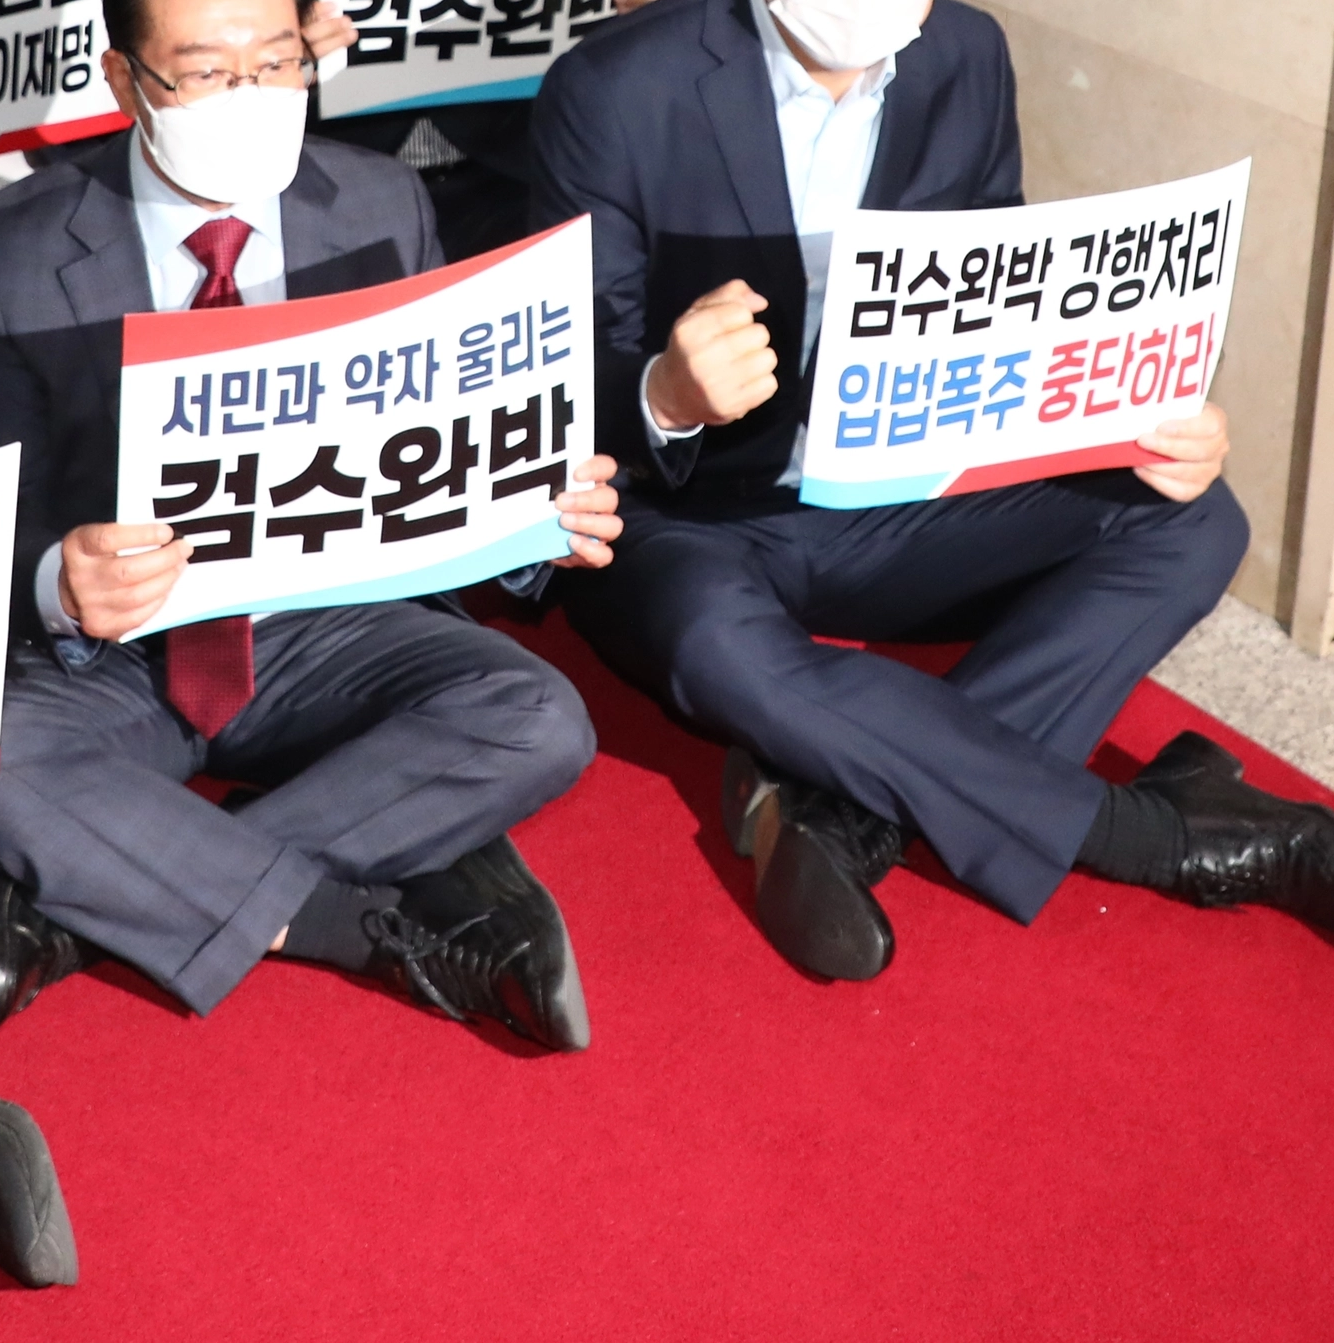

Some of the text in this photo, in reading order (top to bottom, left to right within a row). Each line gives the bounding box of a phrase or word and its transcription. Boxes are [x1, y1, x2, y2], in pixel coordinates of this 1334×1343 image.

[850, 199, 1233, 338] 검수완박 강행처리
[162, 300, 572, 436] 서민과 약자 울리는
[835, 312, 1214, 449] 입법폭주 중단하라
[152, 382, 575, 565] 검수완박
